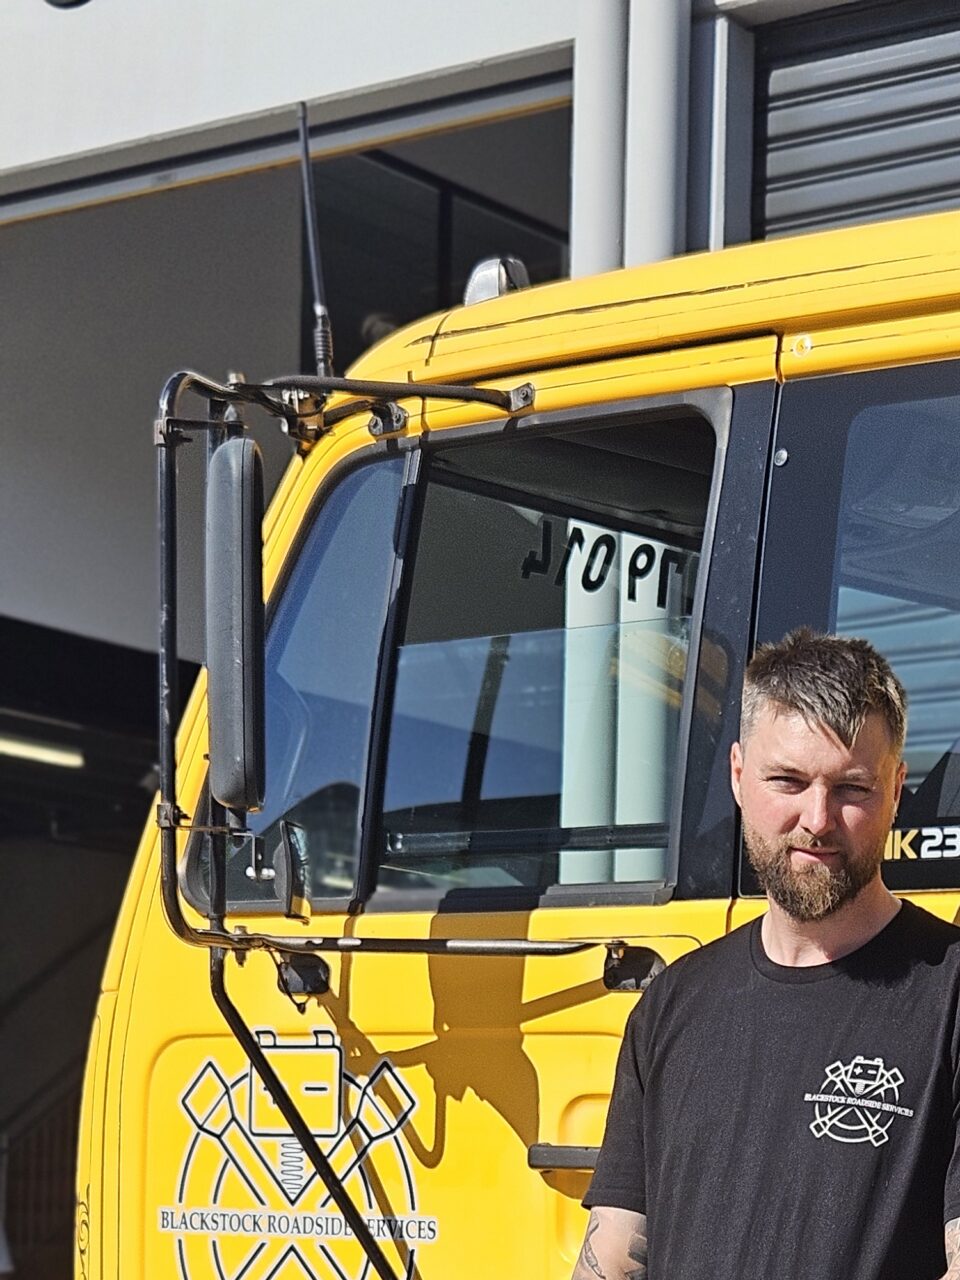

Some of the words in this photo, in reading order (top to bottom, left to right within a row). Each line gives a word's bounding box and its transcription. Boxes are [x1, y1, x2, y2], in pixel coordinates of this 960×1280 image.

[804, 1092, 847, 1104] BLACKSTOCK
[847, 1097, 882, 1110] ROADSIDE
[881, 1102, 914, 1117] SERVICES
[160, 1210, 262, 1233] BLACKSTOCK
[266, 1214, 353, 1236] ROADSIDE
[366, 1217, 437, 1240] ERVICES
